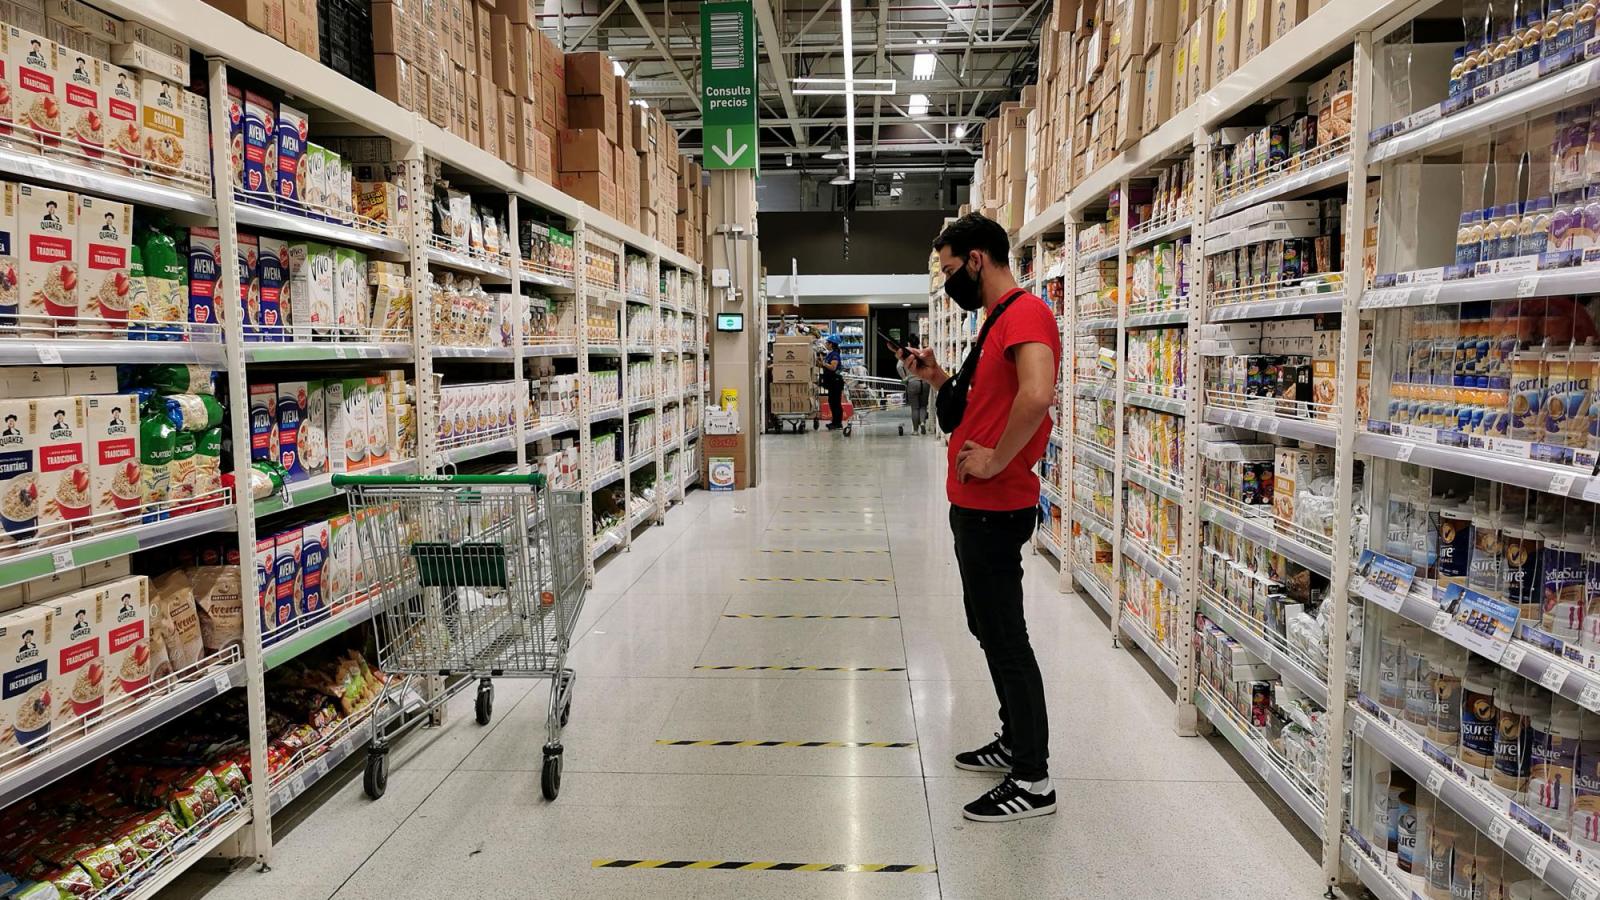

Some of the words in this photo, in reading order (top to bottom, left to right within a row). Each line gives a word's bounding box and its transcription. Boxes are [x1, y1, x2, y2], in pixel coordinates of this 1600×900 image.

[27, 56, 47, 69] QUAKER
[72, 72, 91, 86] QUAKER
[706, 86, 751, 96] Consulta
[710, 97, 748, 110] precios
[248, 124, 266, 143] AVENA
[282, 135, 299, 151] AVENA
[40, 221, 63, 233] QUAKER
[99, 231, 119, 242] QUAKER
[36, 246, 67, 258] TRADICIONAL
[94, 255, 121, 266] TRADICIONAL
[194, 258, 215, 274] AVENA
[264, 267, 282, 281] AVENA
[254, 414, 271, 429] AVENA
[282, 410, 299, 424] AVENA
[50, 430, 73, 441] QUAKER
[107, 426, 127, 436] QUAKER
[0, 435, 24, 447] QUAKER
[47, 454, 78, 466] TRADICIONAL
[104, 449, 131, 460] TRADICIONAL
[307, 552, 322, 568] AVENA
[1471, 560, 1502, 572] sure
[279, 561, 295, 578] AVENA
[117, 610, 137, 624] QUAKER
[70, 627, 92, 641] QUAKER
[114, 631, 140, 647] TRADICIONAL
[16, 649, 39, 664] QUAKER
[66, 650, 95, 667] TRADICIONAL
[9, 672, 43, 691] INSTANTÁNEA
[1399, 837, 1416, 849] ure
